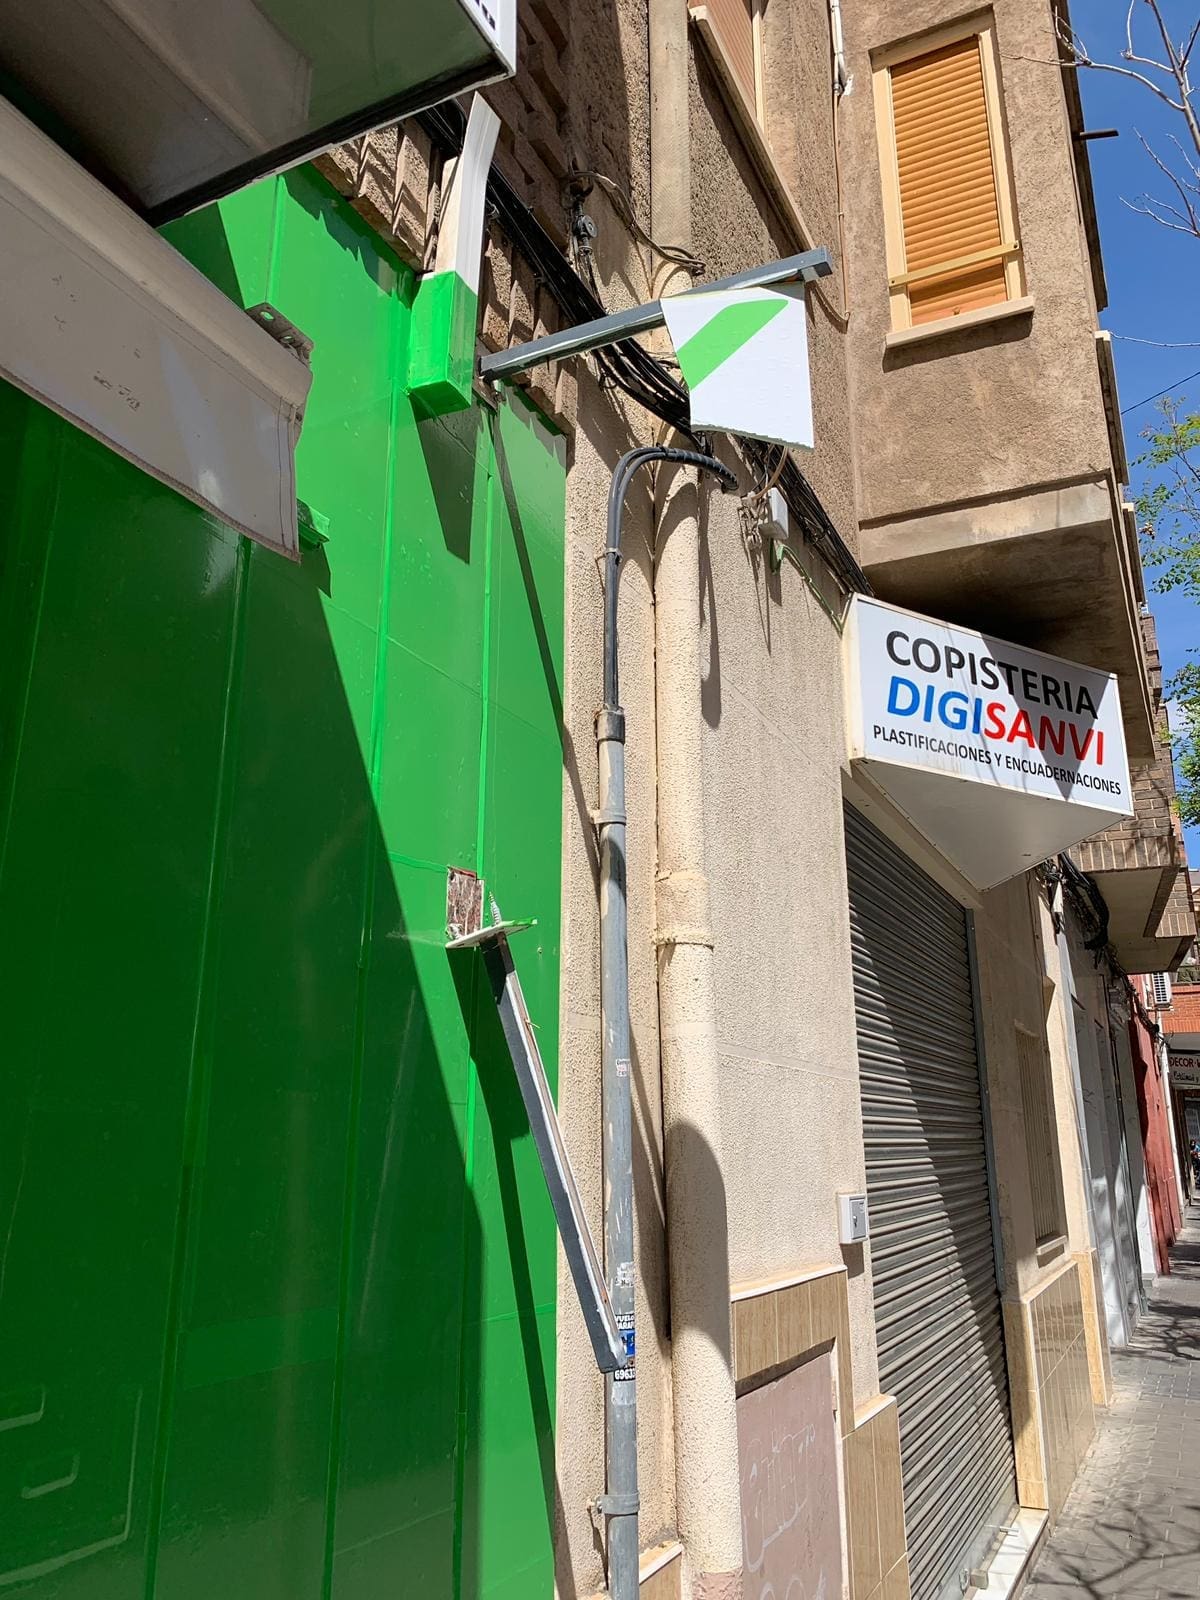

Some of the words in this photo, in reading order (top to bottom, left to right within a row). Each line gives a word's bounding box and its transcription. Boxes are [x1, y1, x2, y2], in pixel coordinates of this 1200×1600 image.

[886, 630, 1098, 720] COPISTERIA
[873, 724, 992, 765] PLASTIFICACIONES
[994, 752, 1002, 767] Y
[1005, 756, 1122, 796] ENCUADERNACIONES
[887, 675, 1104, 766] DIGISANVI
